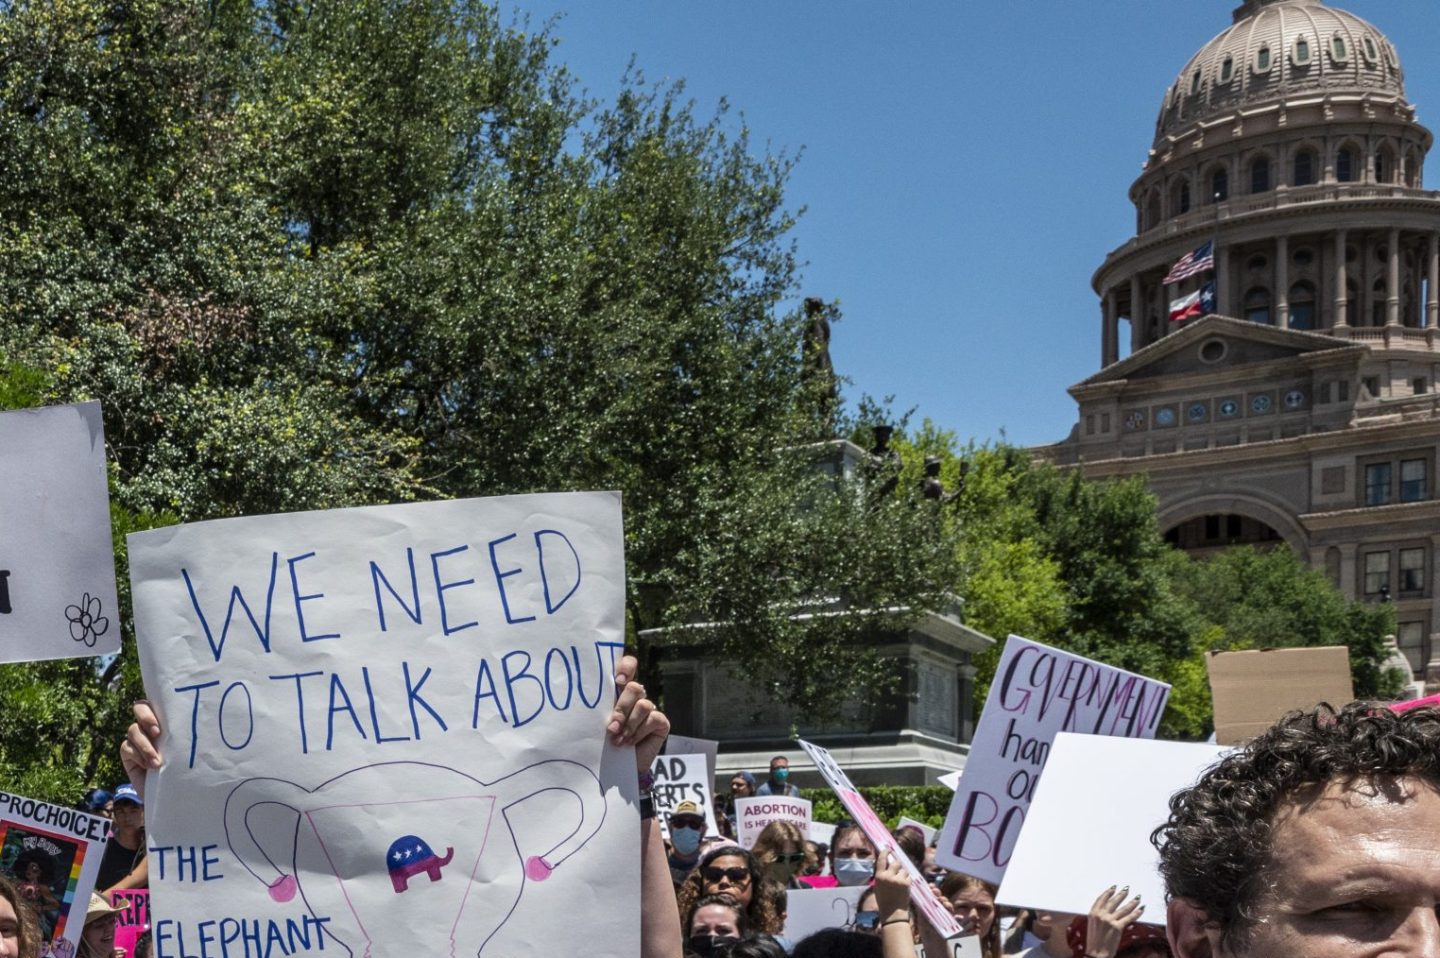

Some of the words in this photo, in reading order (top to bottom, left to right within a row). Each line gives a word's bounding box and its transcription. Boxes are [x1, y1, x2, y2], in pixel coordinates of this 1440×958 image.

[181, 551, 342, 662] WE
[369, 529, 583, 637] NEED
[174, 680, 255, 768] TO
[269, 660, 447, 755] TALK
[472, 641, 625, 730] ABOUT
[744, 804, 806, 818] ABORTION
[744, 821, 754, 829] IS
[149, 845, 224, 882] THE
